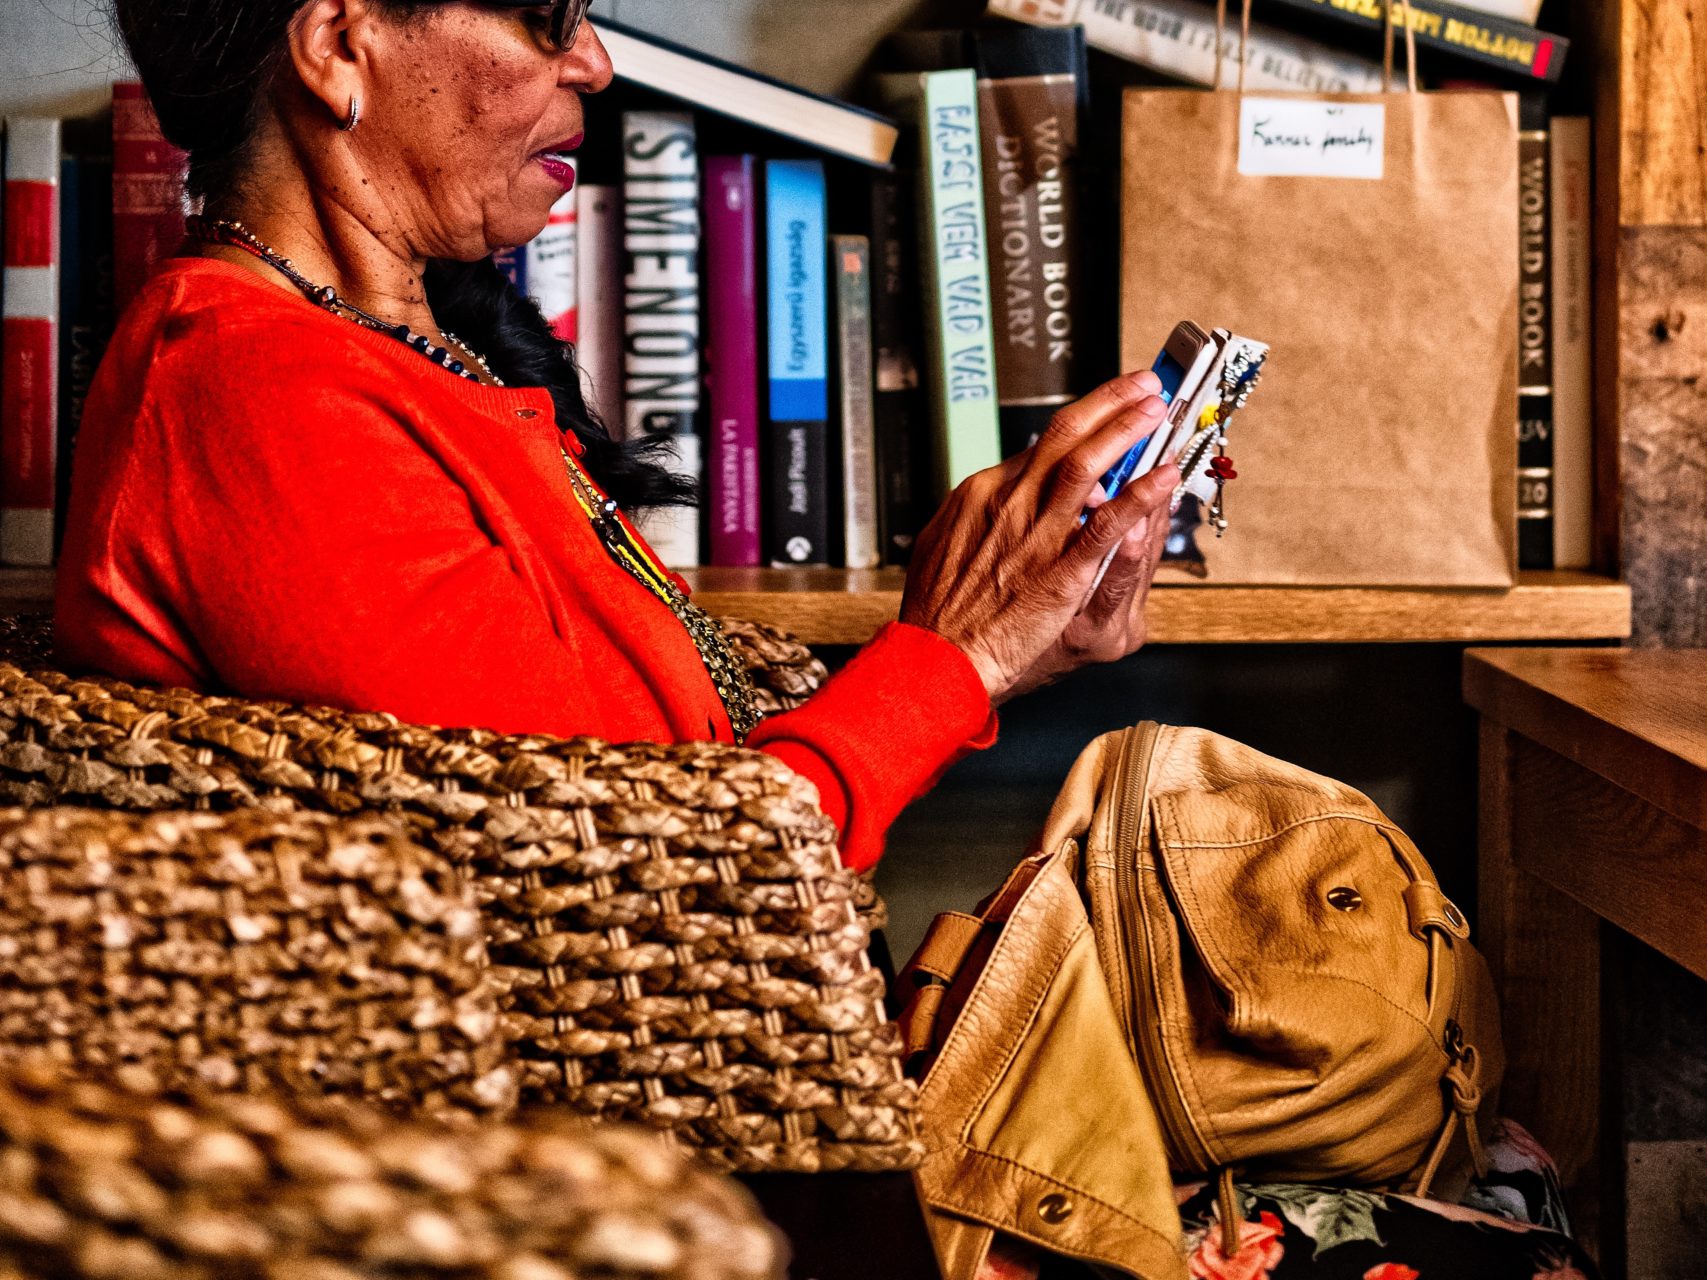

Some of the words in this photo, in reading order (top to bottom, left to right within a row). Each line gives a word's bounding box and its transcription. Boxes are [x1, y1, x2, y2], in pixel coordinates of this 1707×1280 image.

[1132, 4, 1184, 42] HOUR
[1443, 16, 1534, 65] BOTTOM
[1033, 117, 1064, 250] WORLD
[1521, 158, 1544, 274] WORLD
[624, 130, 699, 411] SIMENON
[942, 200, 980, 263] VEM
[995, 135, 1036, 350] DICTIONARY
[947, 274, 984, 335] VAD
[1041, 261, 1073, 363] BOOK
[1520, 281, 1544, 369] BOOK
[951, 345, 990, 402] VAR
